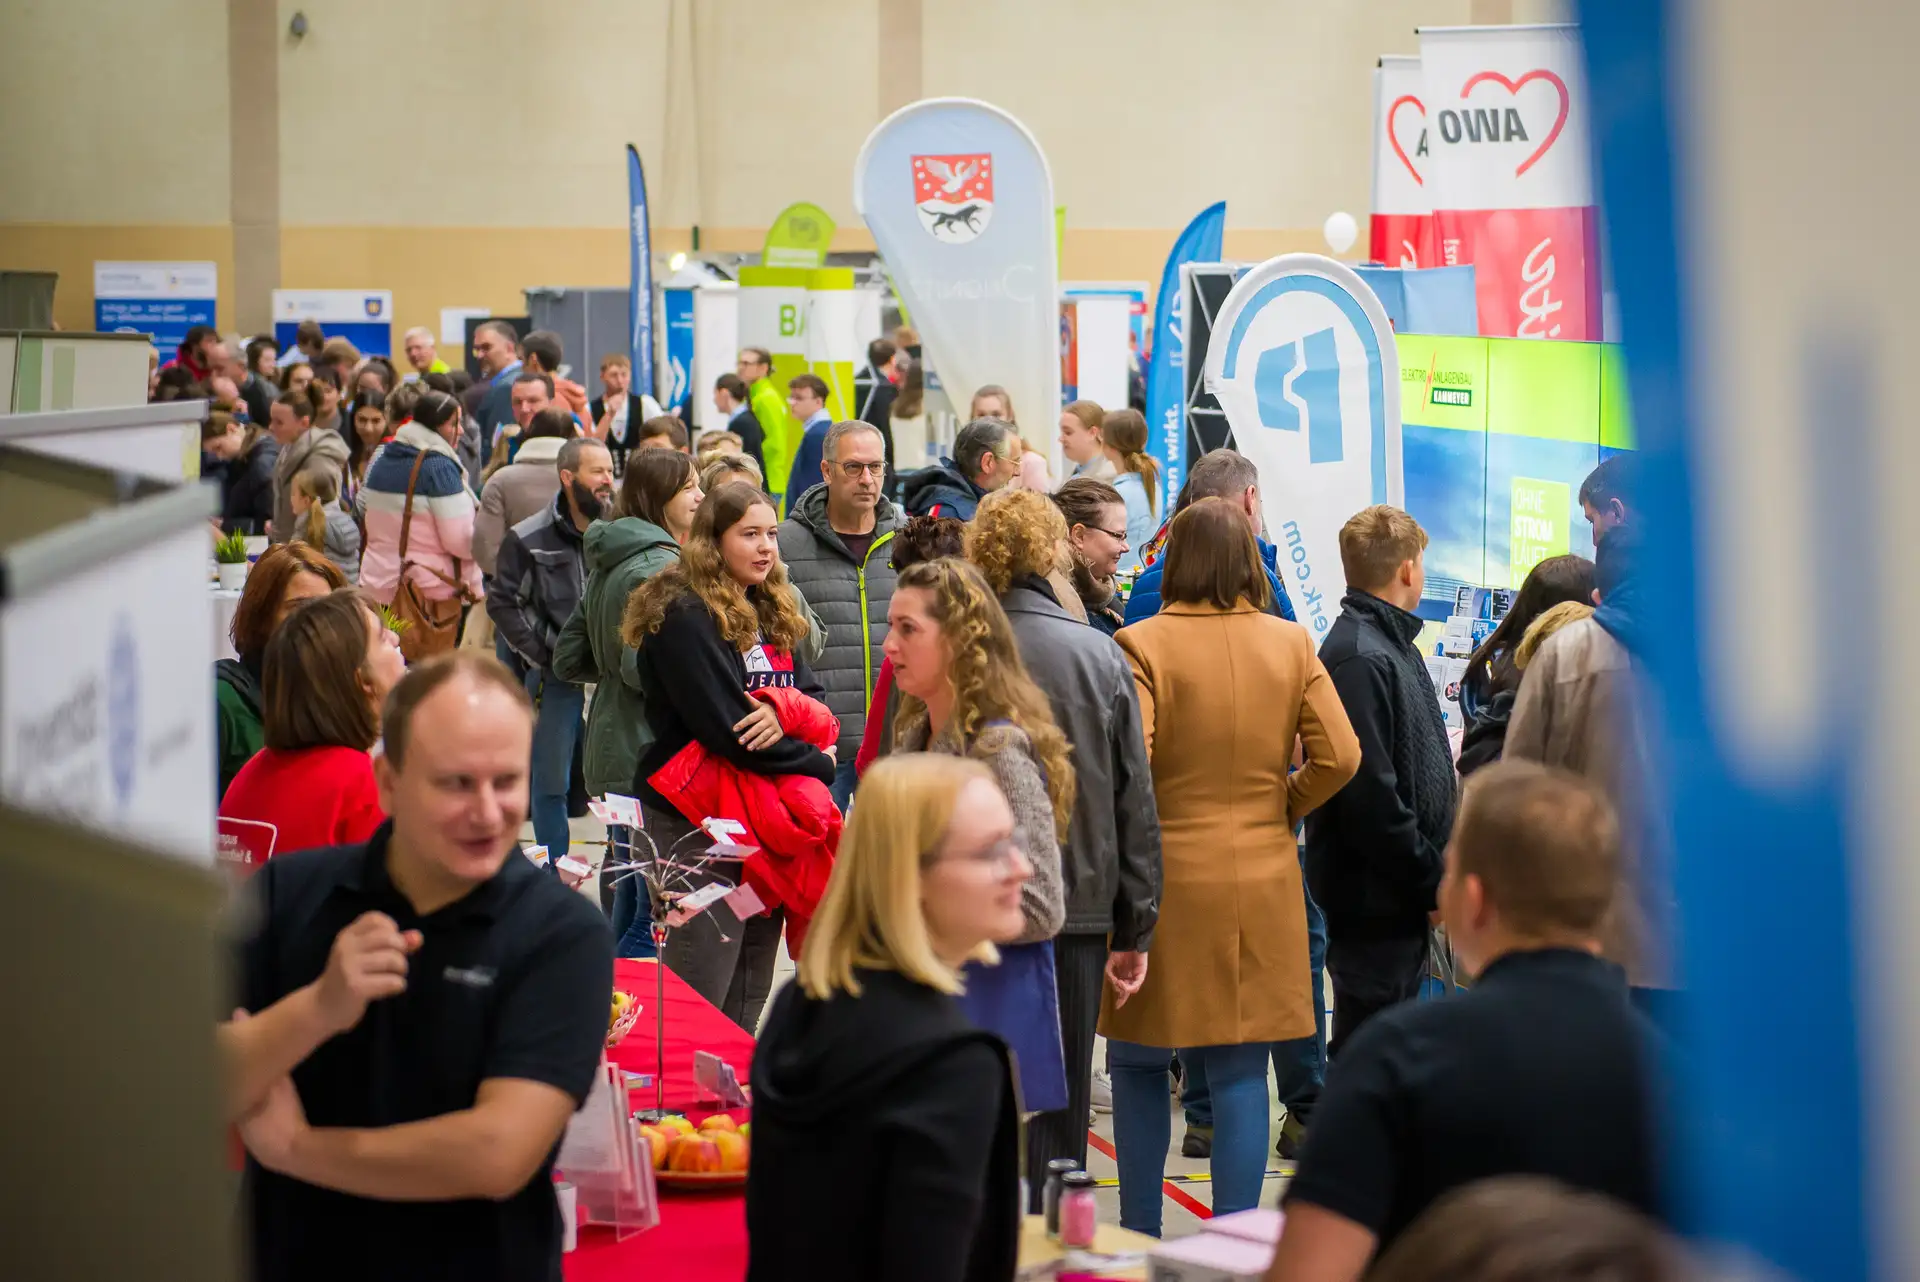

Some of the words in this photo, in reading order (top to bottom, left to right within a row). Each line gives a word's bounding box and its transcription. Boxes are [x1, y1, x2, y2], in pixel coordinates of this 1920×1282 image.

[1433, 390, 1470, 405] KAMMEYER
[1514, 487, 1546, 514] OHNE
[1514, 516, 1554, 542] STROM
[746, 673, 794, 688] JEANS
